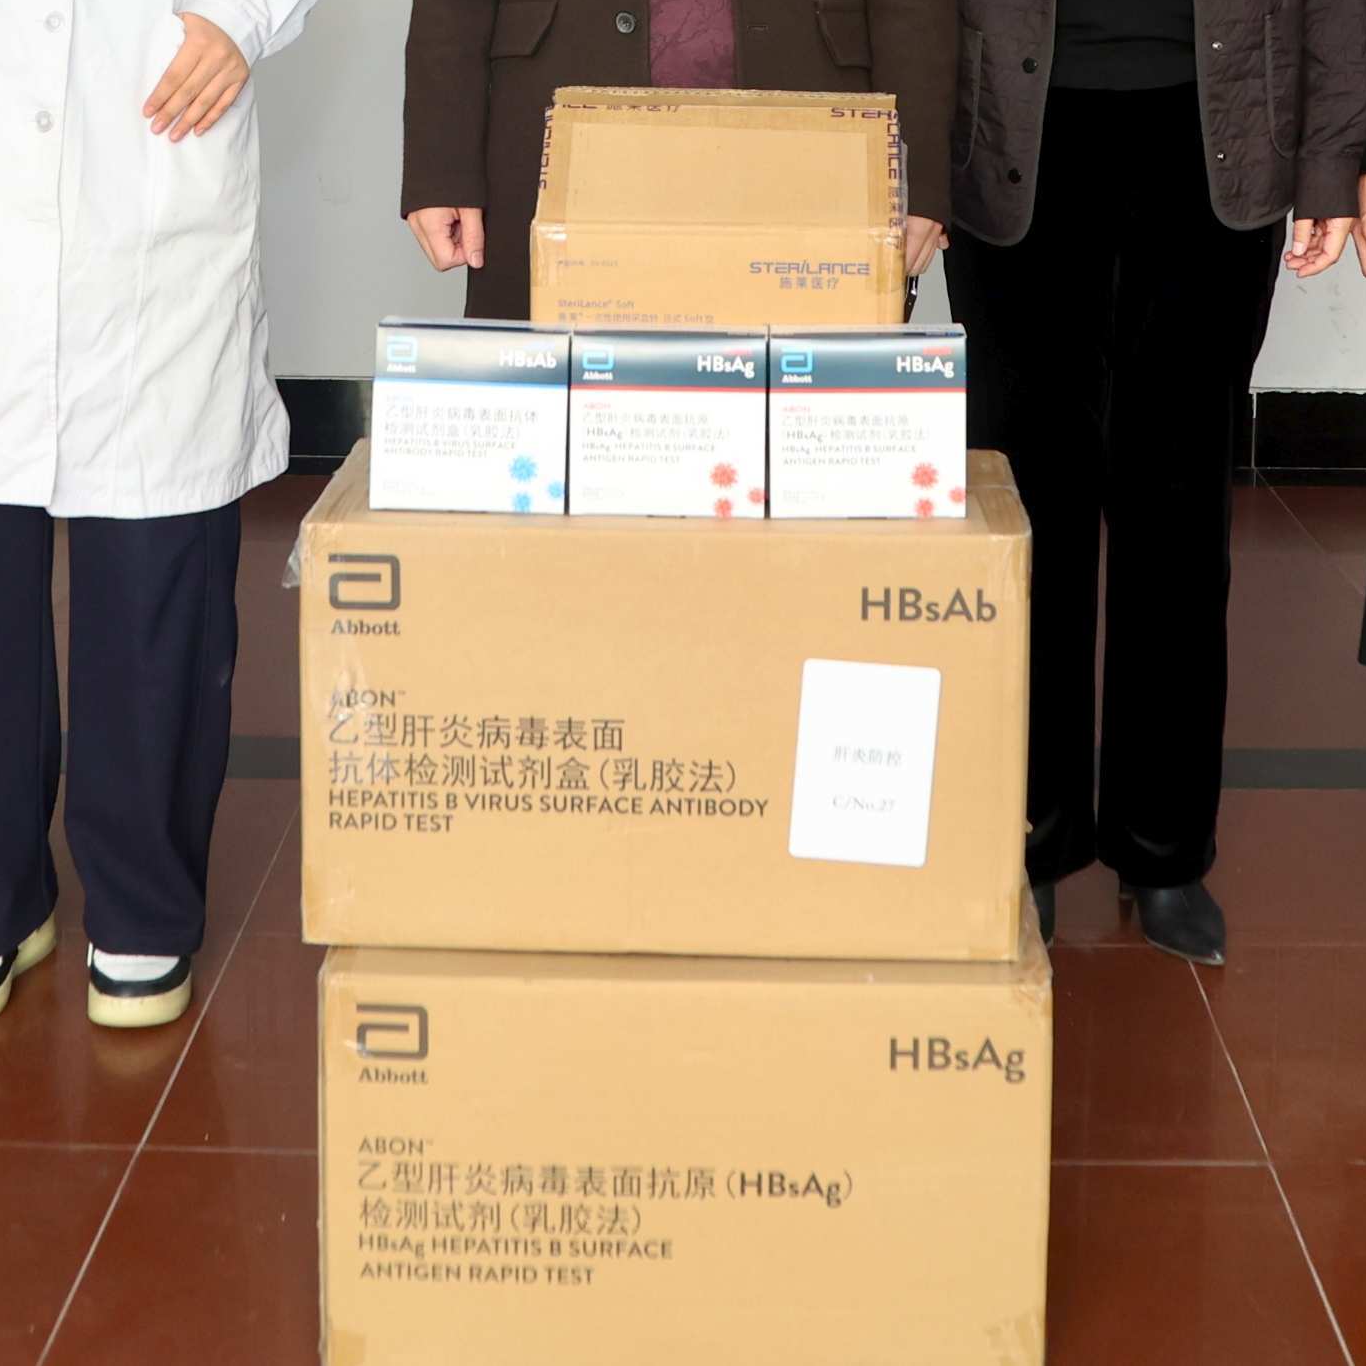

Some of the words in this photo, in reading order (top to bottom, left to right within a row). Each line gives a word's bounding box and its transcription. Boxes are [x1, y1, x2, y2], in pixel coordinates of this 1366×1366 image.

[498, 348, 557, 369] HBsAb
[696, 355, 755, 379] HBsAg
[896, 355, 955, 379] HBsAg
[860, 586, 998, 623] HBsAb
[331, 618, 401, 635] Abbott
[329, 712, 624, 752] 乙型肝炎病毒表面
[328, 789, 437, 810] HEPATITIS
[446, 793, 458, 810] B
[465, 794, 533, 812] VIRUS
[539, 795, 643, 815] SURFACE
[649, 797, 769, 817] ANTIBODY
[328, 813, 397, 832] RAPID
[404, 815, 454, 833] TEST
[890, 1036, 1026, 1084] HBsAg
[358, 1067, 428, 1085] Abbott
[358, 1235, 425, 1259] HBsAg
[431, 1237, 542, 1257] HEPATITIS
[549, 1239, 562, 1257] B
[569, 1240, 673, 1259] SURFACE
[360, 1261, 462, 1282] ANTIGEN
[468, 1264, 538, 1284] RAPID
[546, 1266, 594, 1285] TEST
